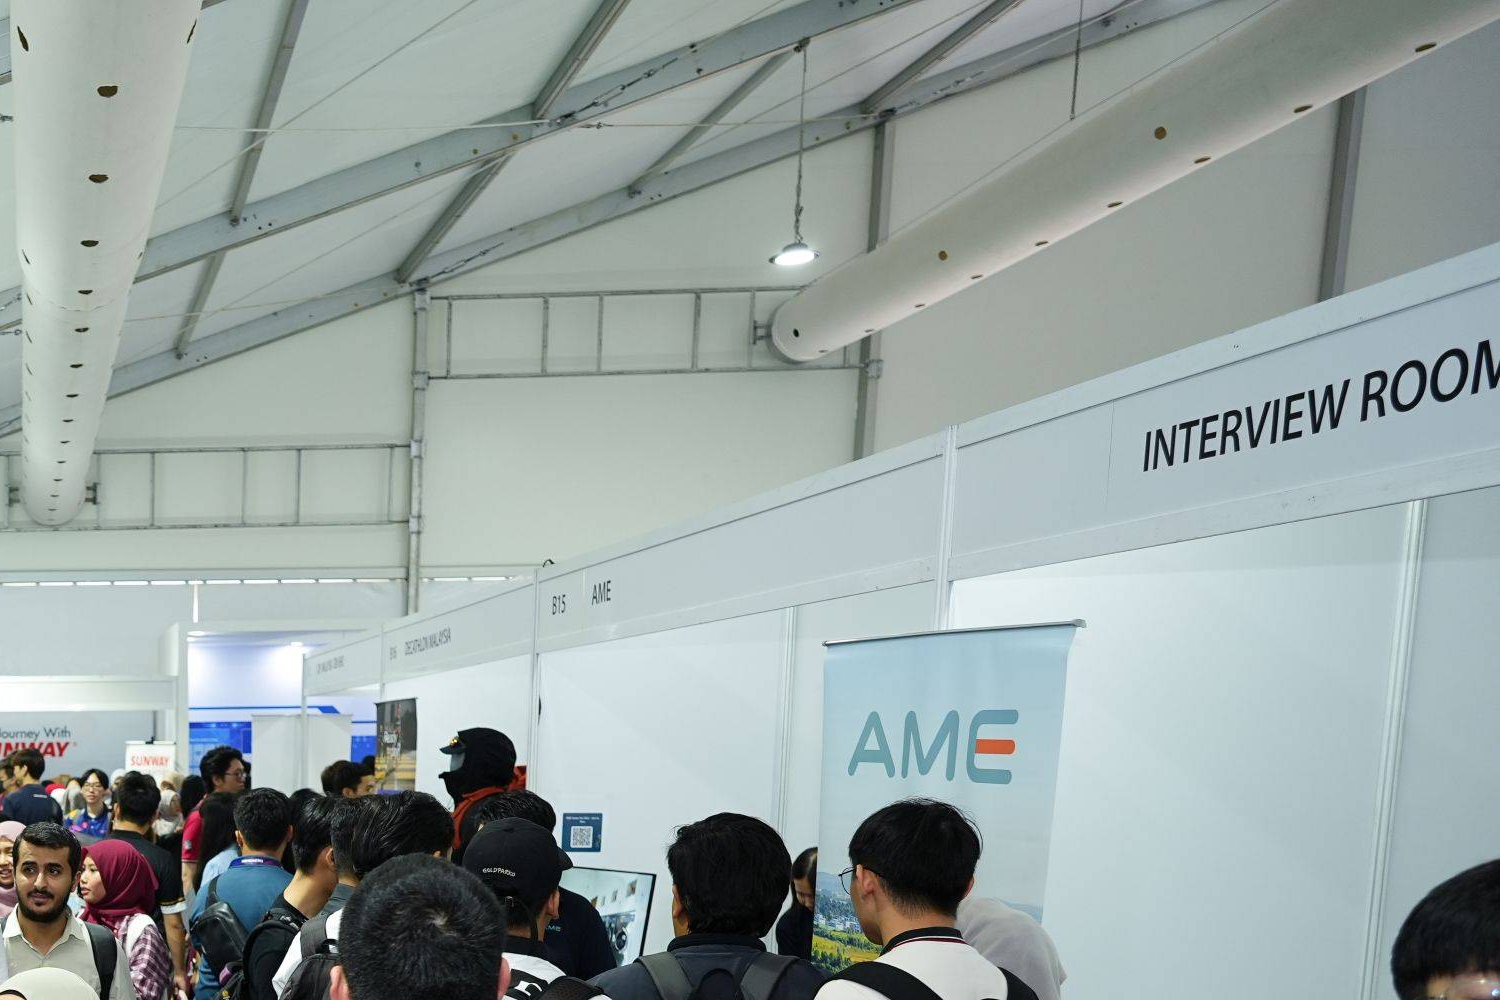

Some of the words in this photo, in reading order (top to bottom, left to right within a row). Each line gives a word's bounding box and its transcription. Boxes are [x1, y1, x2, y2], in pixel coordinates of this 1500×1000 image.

[1142, 379, 1351, 472] INTERVIEW
[552, 594, 566, 616] B15
[591, 580, 612, 606] AME
[43, 725, 71, 738] With
[846, 707, 1019, 786] AME
[130, 755, 171, 767] SUNWAY
